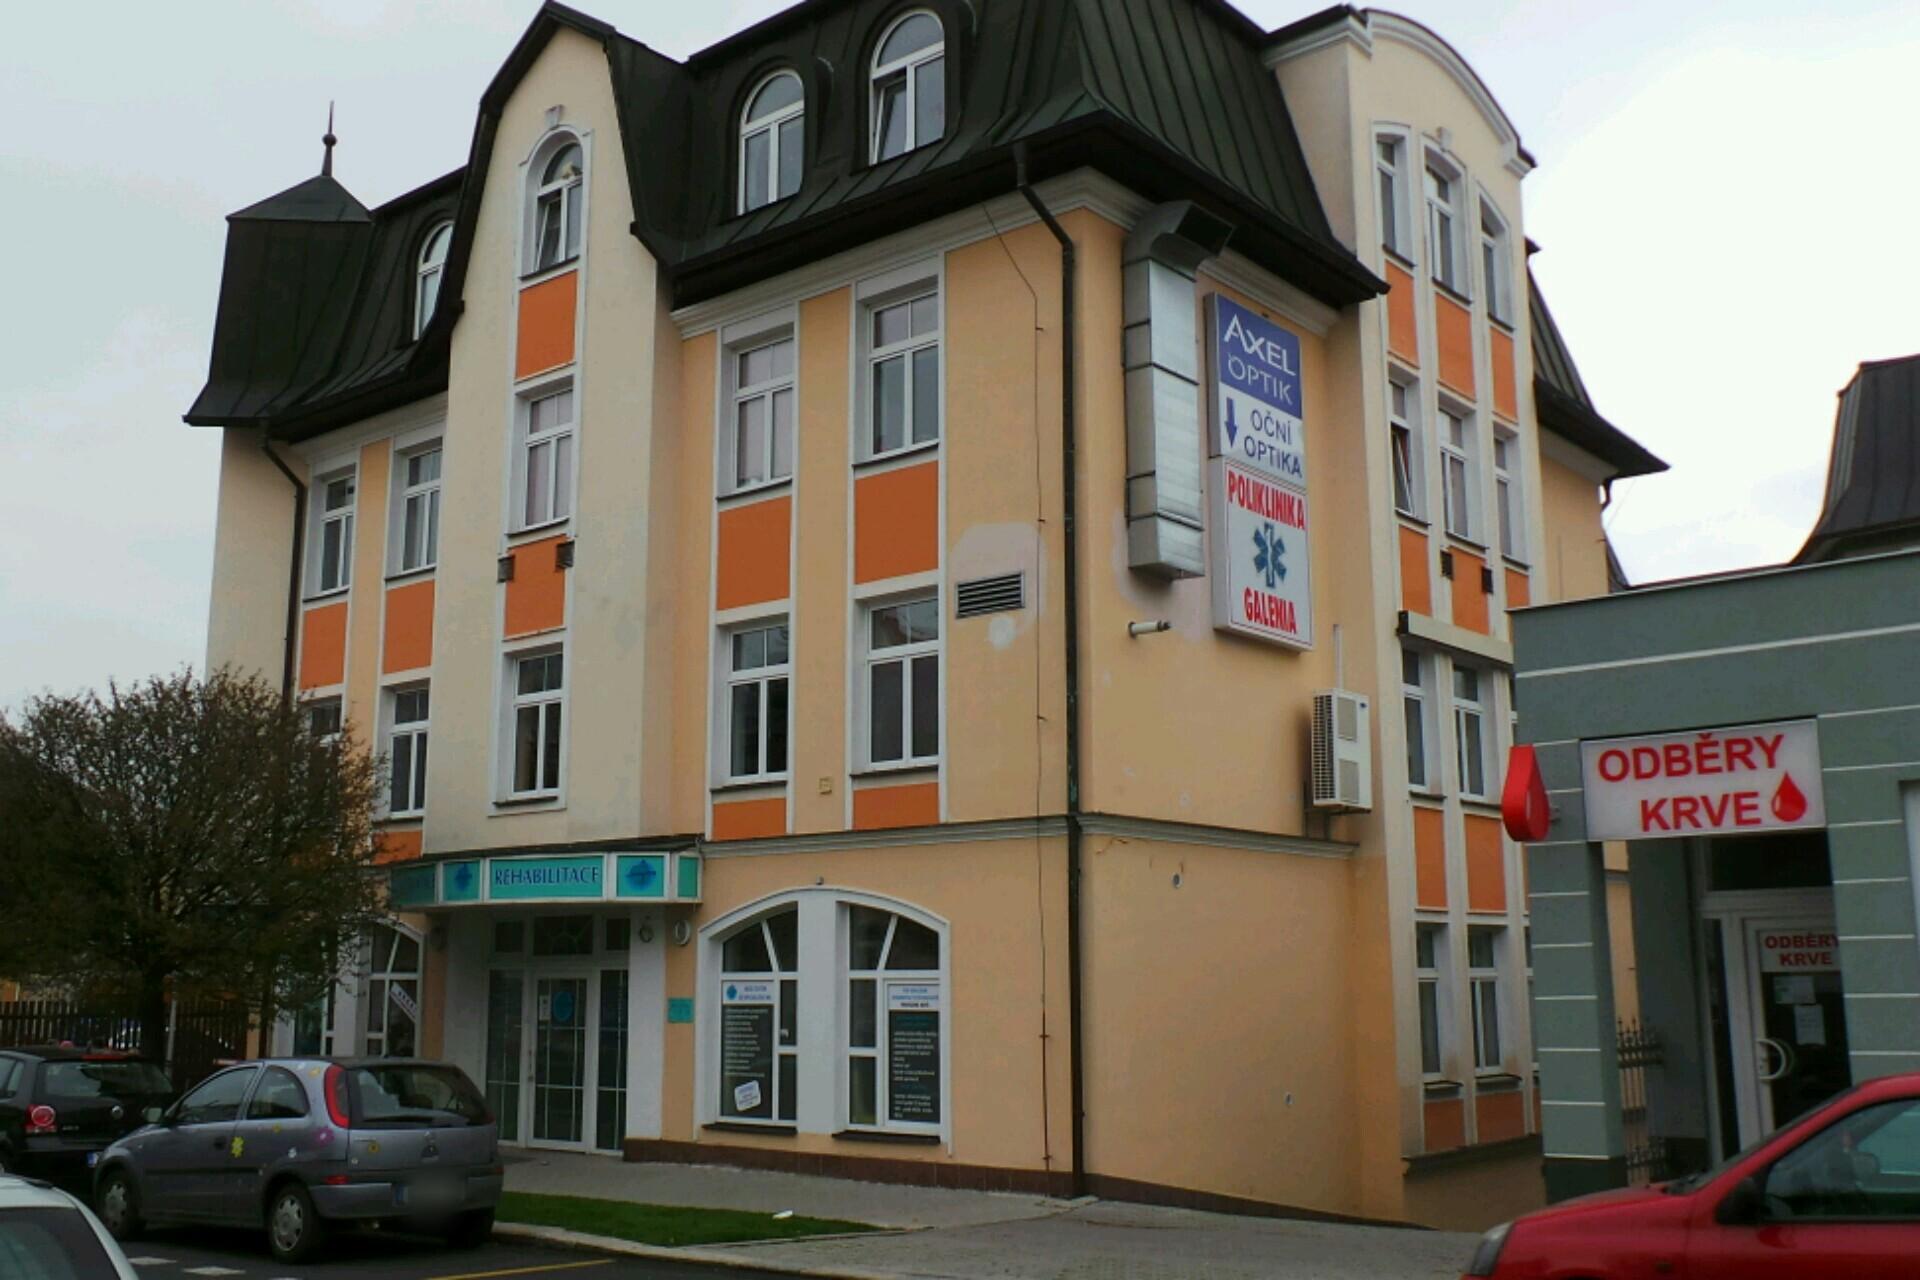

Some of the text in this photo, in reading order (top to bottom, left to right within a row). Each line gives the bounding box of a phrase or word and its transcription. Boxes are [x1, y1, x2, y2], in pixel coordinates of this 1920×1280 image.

[1223, 313, 1297, 377] AXEL
[1228, 352, 1294, 406] OPTIK
[1251, 408, 1293, 446] OČNÍ
[1244, 435, 1303, 479] OPTIKA
[1228, 470, 1306, 530] POLIKLINIKA
[1244, 586, 1297, 634] GALENIA
[1598, 733, 1784, 783] ODBĚRY
[1640, 791, 1762, 832] KRVE
[494, 866, 600, 886] REHABILITACE
[1779, 951, 1833, 966] KRVE
